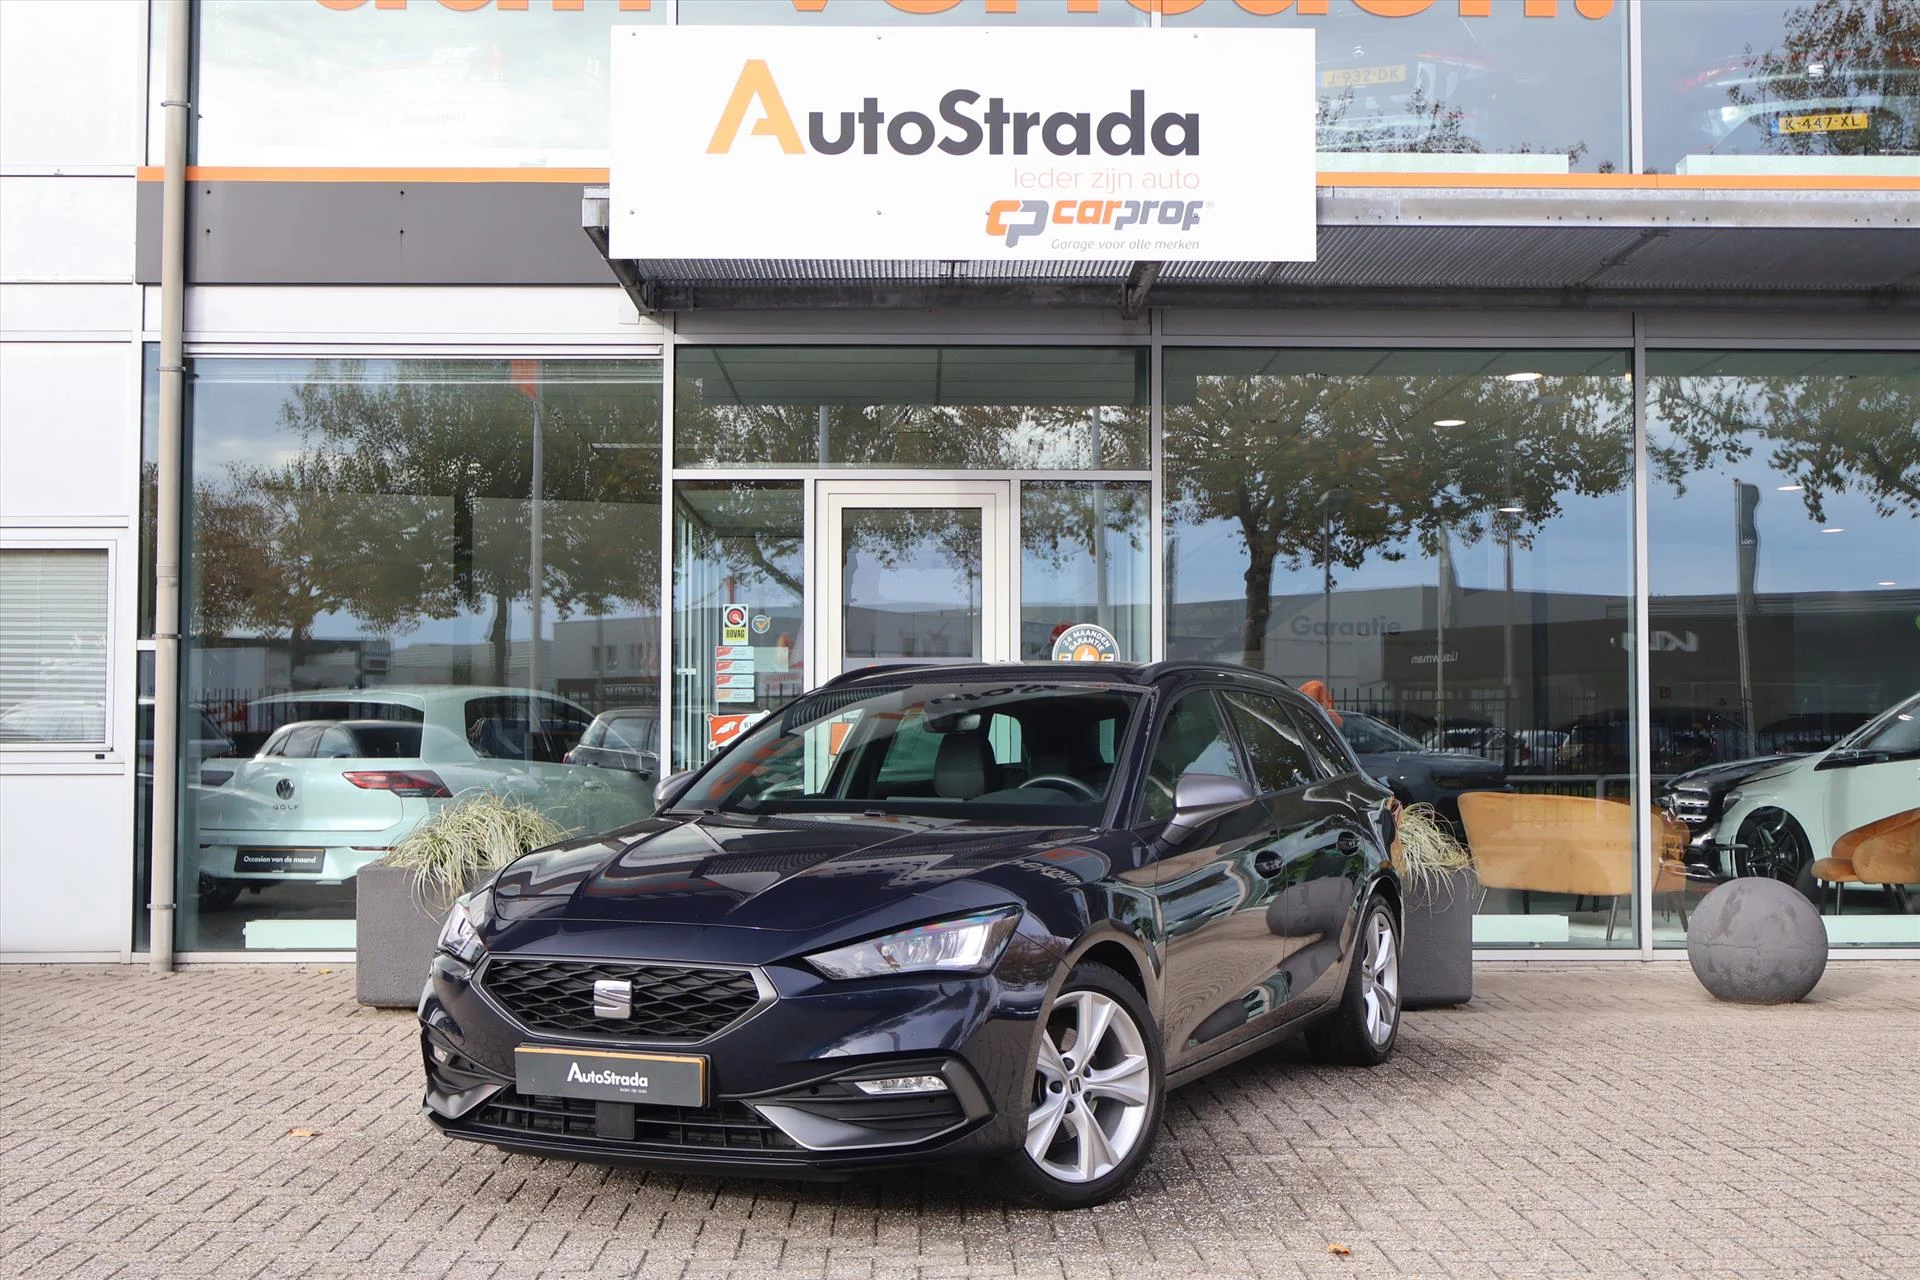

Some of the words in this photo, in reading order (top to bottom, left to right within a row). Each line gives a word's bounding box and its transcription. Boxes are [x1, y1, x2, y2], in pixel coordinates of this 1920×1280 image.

[1327, 66, 1400, 85] J-932-DK
[705, 59, 1200, 156] AutoStrada
[1785, 116, 1860, 130] K-447-XL
[1013, 168, 1081, 189] Ieder
[1091, 168, 1132, 194] zijn
[1141, 169, 1200, 190] auto
[1052, 200, 1203, 231] carprof
[1051, 239, 1095, 252] Garage
[1099, 240, 1126, 250] voor
[1129, 239, 1151, 250] alle
[1154, 239, 1200, 250] merken
[726, 628, 745, 639] BOVAG
[1290, 614, 1402, 637] Garantie
[1063, 637, 1073, 647] 24
[1072, 629, 1112, 648] MAANDEN
[1068, 636, 1105, 653] GARANTIE
[243, 855, 271, 863] Occasion
[284, 855, 293, 863] de
[293, 855, 317, 864] maand
[566, 1062, 648, 1088] AutoStrada
